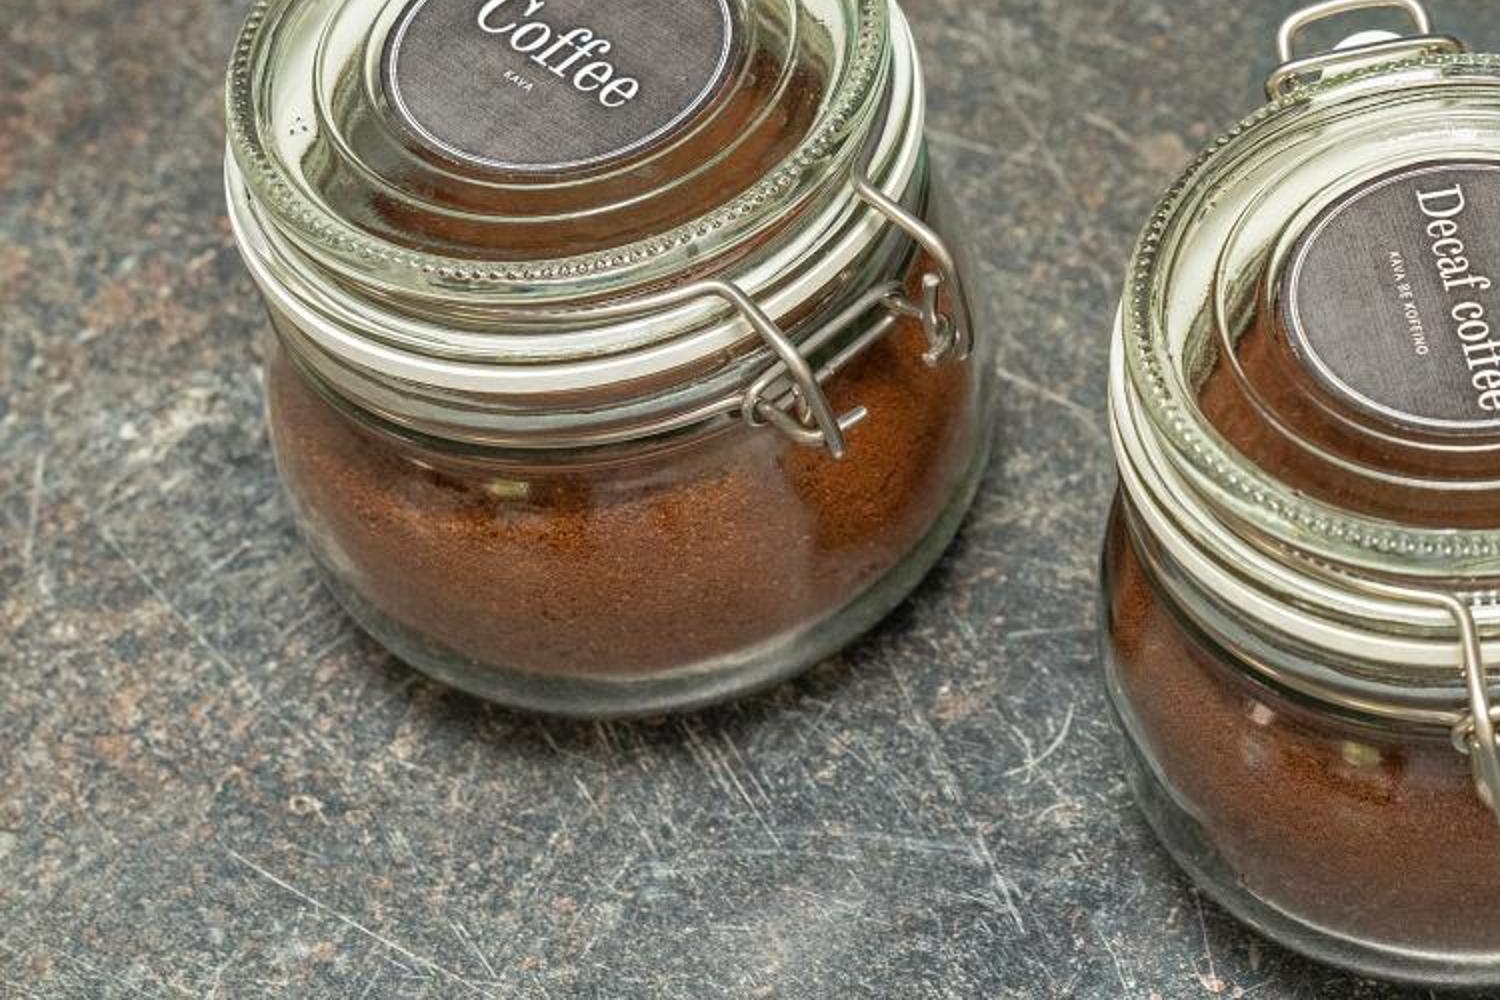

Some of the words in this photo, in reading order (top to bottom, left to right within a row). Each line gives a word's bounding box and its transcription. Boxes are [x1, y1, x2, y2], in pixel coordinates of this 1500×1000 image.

[503, 69, 535, 93] KAVA
[1416, 184, 1491, 293] Decaf
[1387, 251, 1406, 282] KAVA
[1395, 282, 1413, 300] BE
